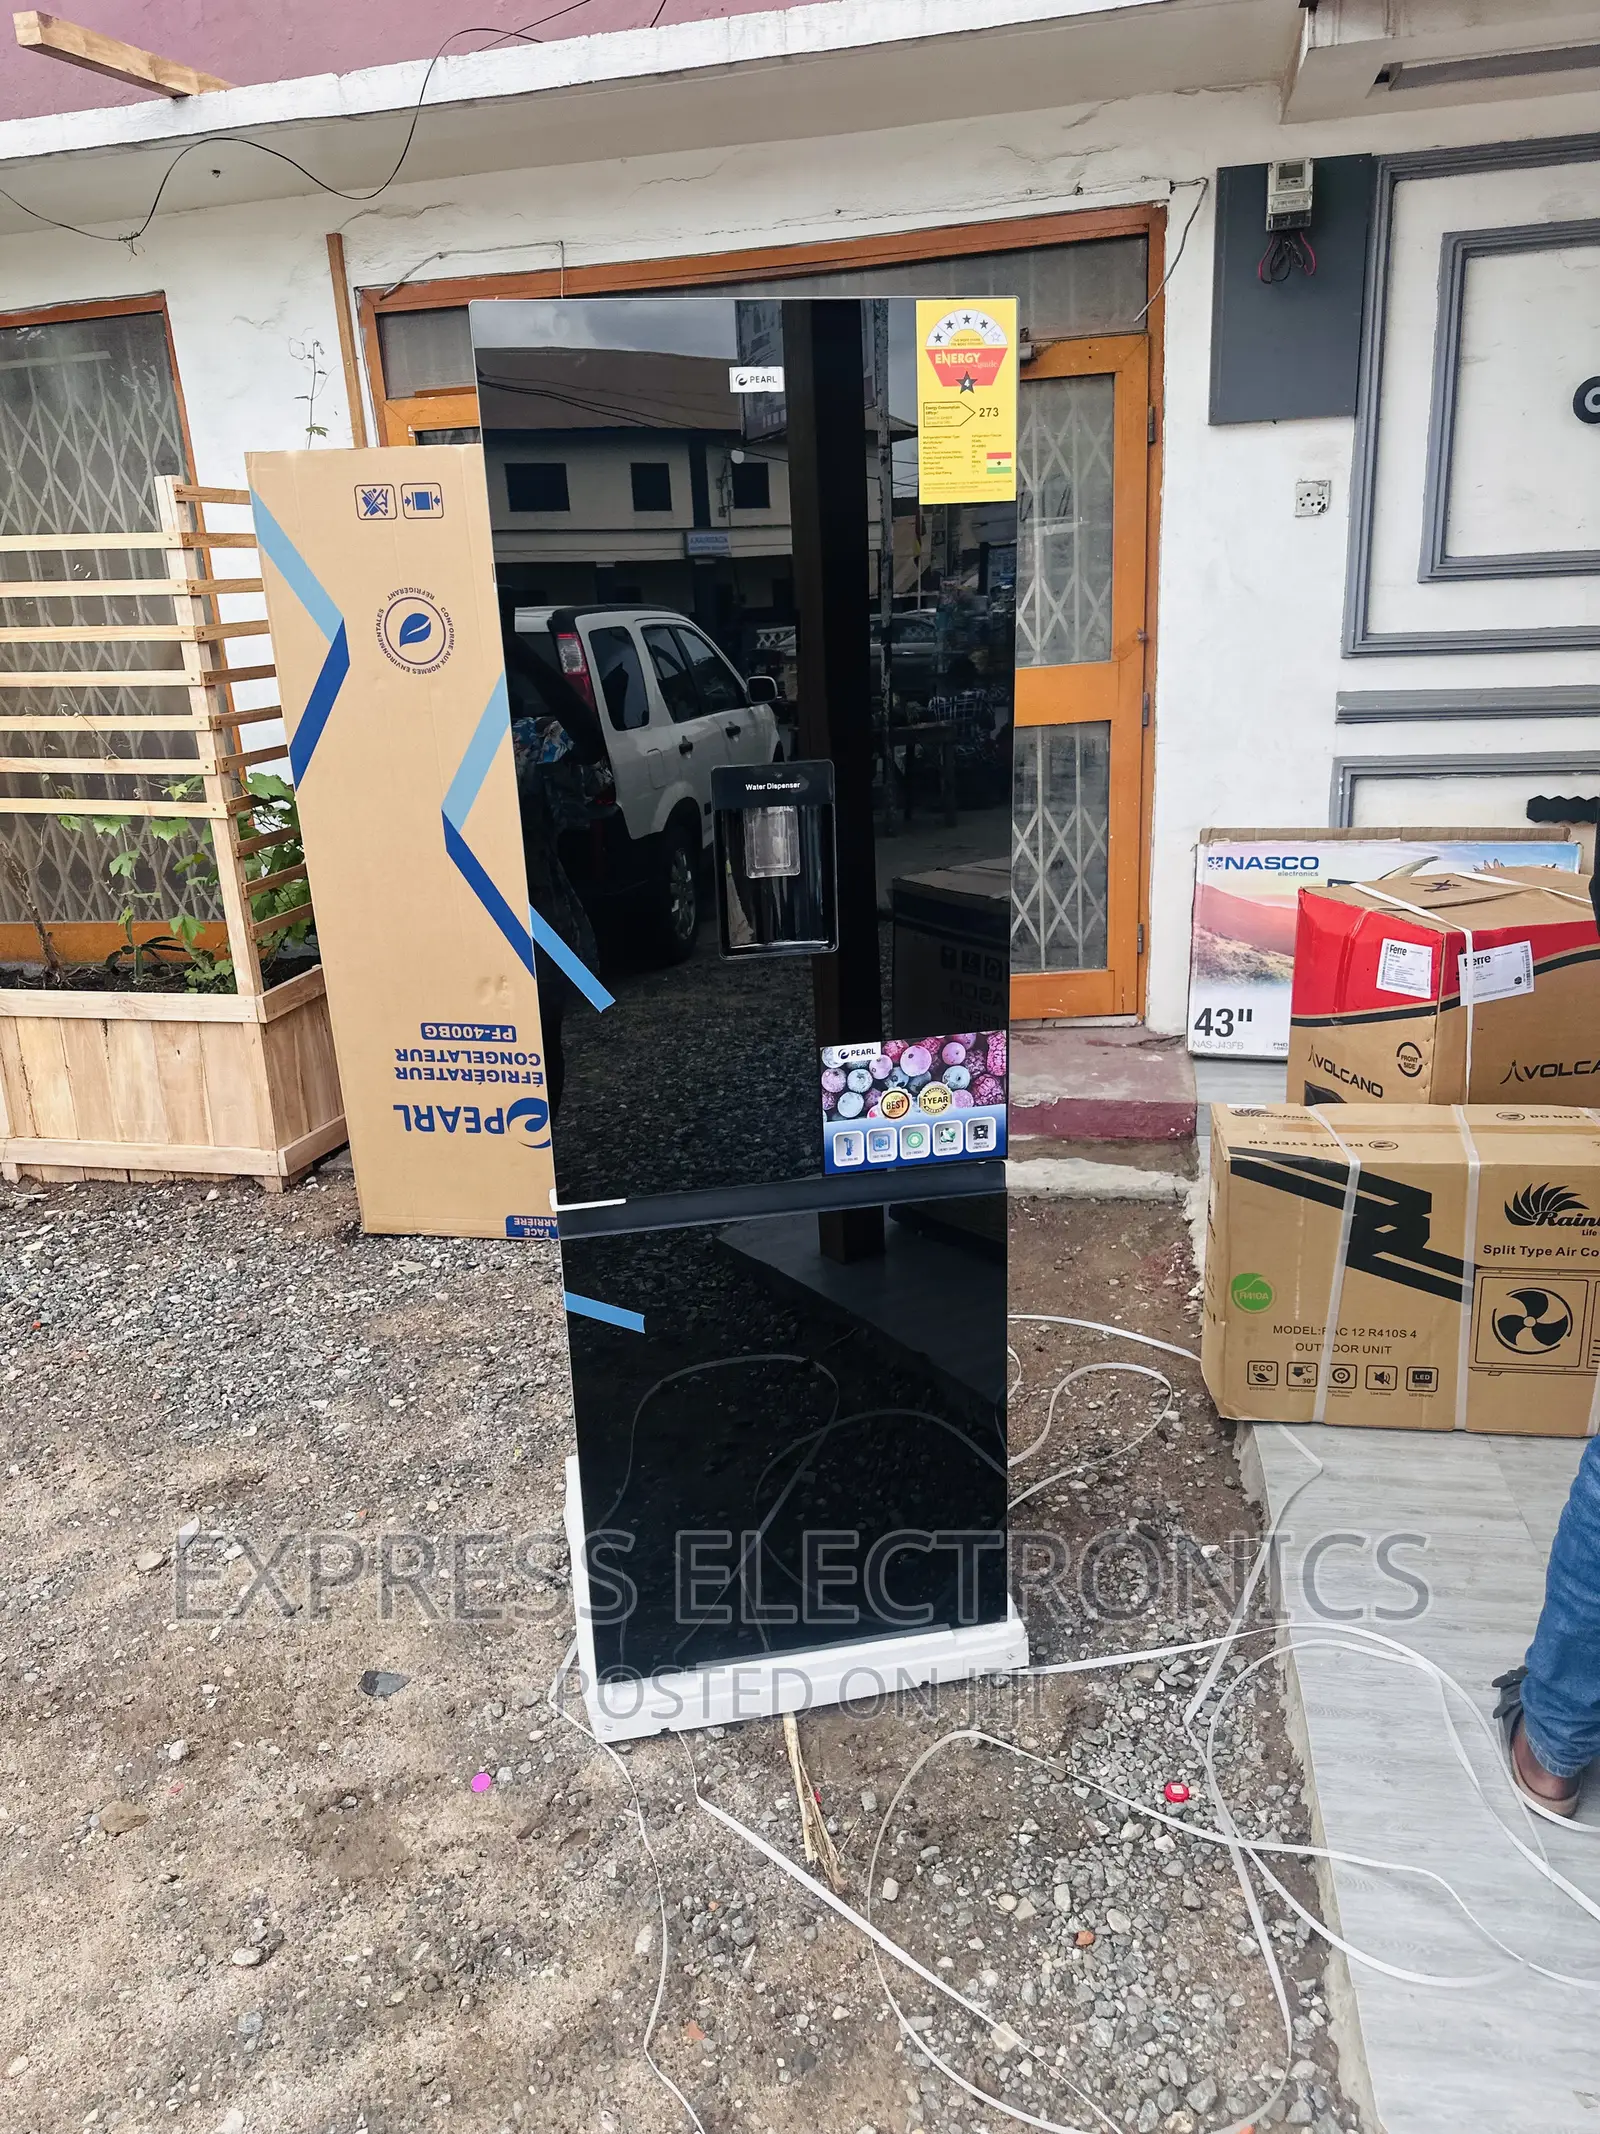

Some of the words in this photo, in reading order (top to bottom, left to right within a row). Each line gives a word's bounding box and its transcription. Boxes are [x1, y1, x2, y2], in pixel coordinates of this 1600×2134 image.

[935, 350, 981, 367] ENERGY
[749, 375, 778, 384] PEARL
[979, 407, 1000, 418] 273
[440, 606, 455, 651] CONFORME
[440, 651, 452, 666] AUX
[745, 783, 766, 791] Water
[766, 781, 801, 791] Dispenser
[1225, 856, 1320, 870] NASCO
[1389, 944, 1408, 957] Ferre
[1194, 1007, 1253, 1038] 43"
[424, 1025, 514, 1041] PF-400BG
[850, 1048, 877, 1057] PEARL
[1400, 1055, 1419, 1063] FRONT
[1403, 1062, 1416, 1070] SIDE
[1315, 1053, 1384, 1099] VOLCANO
[886, 1100, 905, 1110] BEST
[927, 1096, 949, 1105] YEAR
[393, 1104, 506, 1134] PEARL
[524, 1228, 550, 1237] FACE
[1582, 1229, 1598, 1237] Life
[1483, 1244, 1516, 1257] Split
[1520, 1245, 1552, 1258] Type
[1555, 1246, 1577, 1257] Air
[1239, 1291, 1270, 1301] R410A
[1352, 1328, 1366, 1337] 12
[1368, 1328, 1407, 1338] R410S
[1409, 1330, 1417, 1338] 4
[1295, 1342, 1360, 1354] OUTOOR
[1362, 1345, 1392, 1355] UNIT
[1252, 1364, 1273, 1372] ECO
[1415, 1373, 1431, 1381] LED
